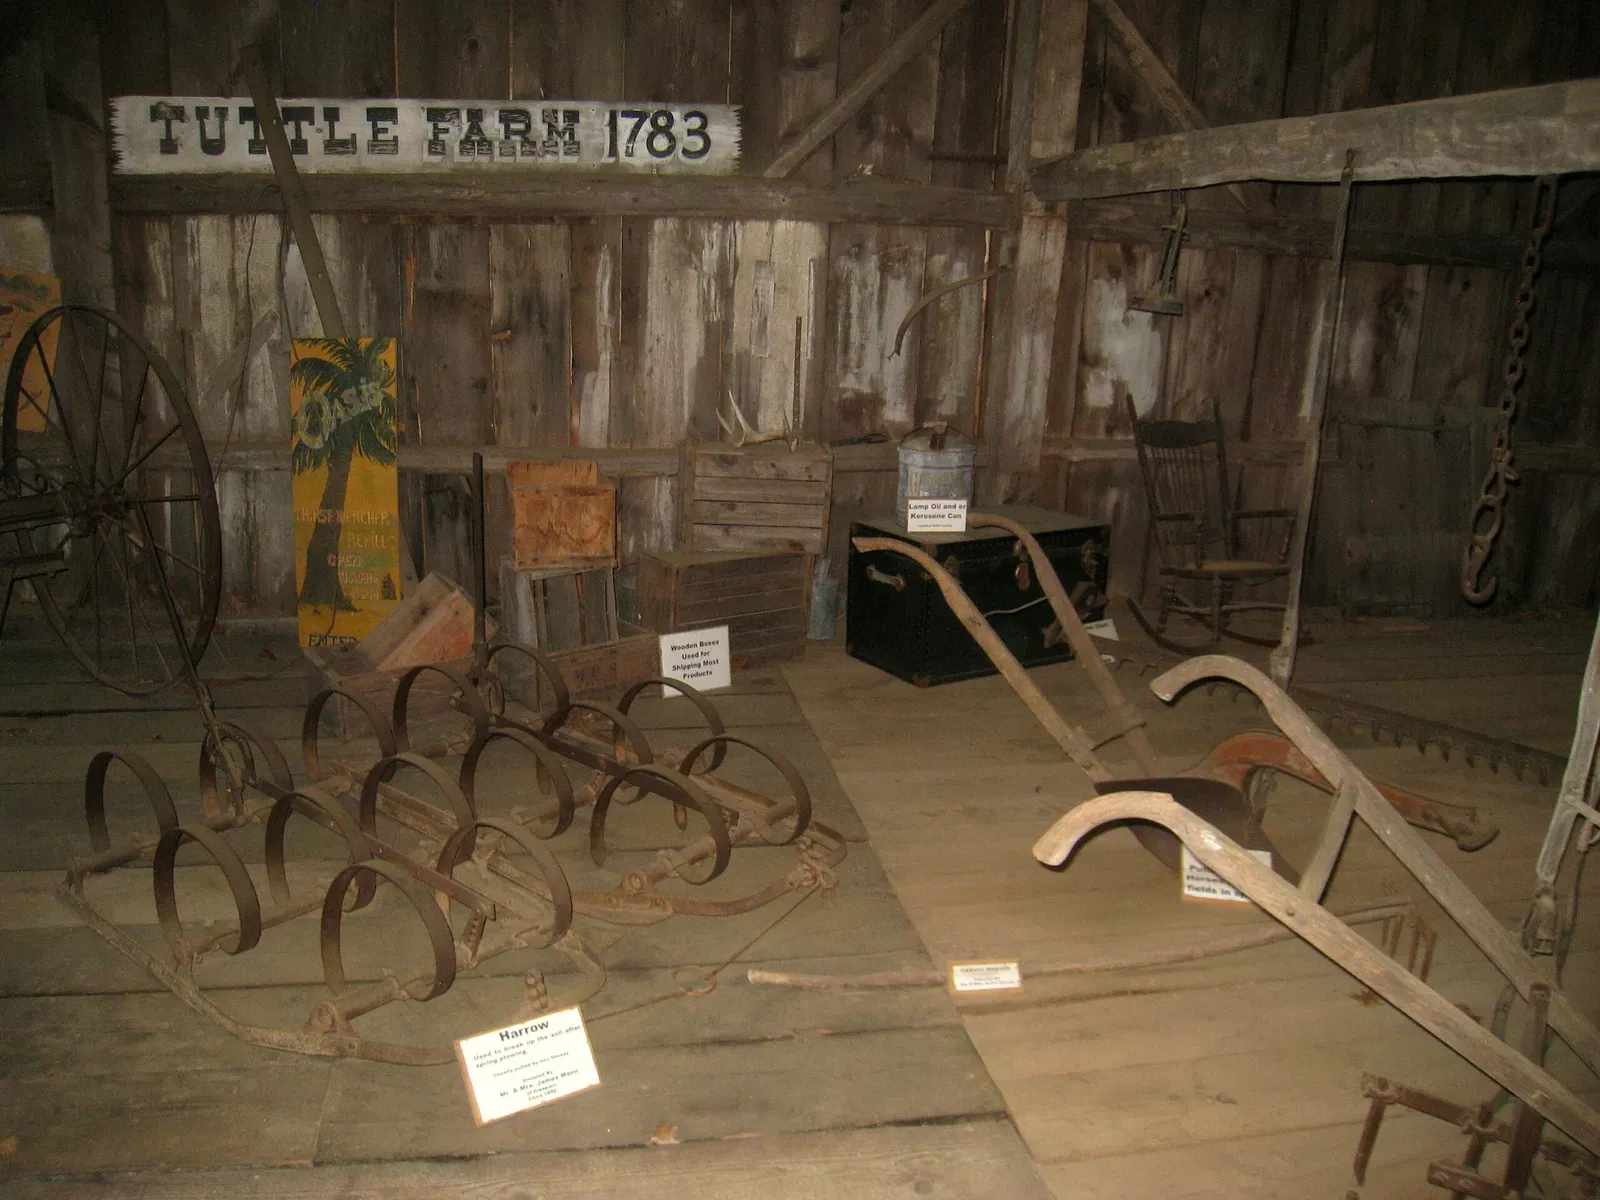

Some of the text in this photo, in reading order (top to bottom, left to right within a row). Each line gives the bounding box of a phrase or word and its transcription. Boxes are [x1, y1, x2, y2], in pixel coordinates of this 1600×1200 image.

[150, 105, 713, 159] TUTTLE FARM 1783
[671, 643, 698, 651] Wooden
[682, 652, 699, 660] Used
[672, 662, 702, 671] Shipping
[683, 670, 712, 679] Products
[500, 1021, 549, 1042] Harrow
[473, 1025, 581, 1061] Used to break up the soil after
[475, 1056, 499, 1069] spring
